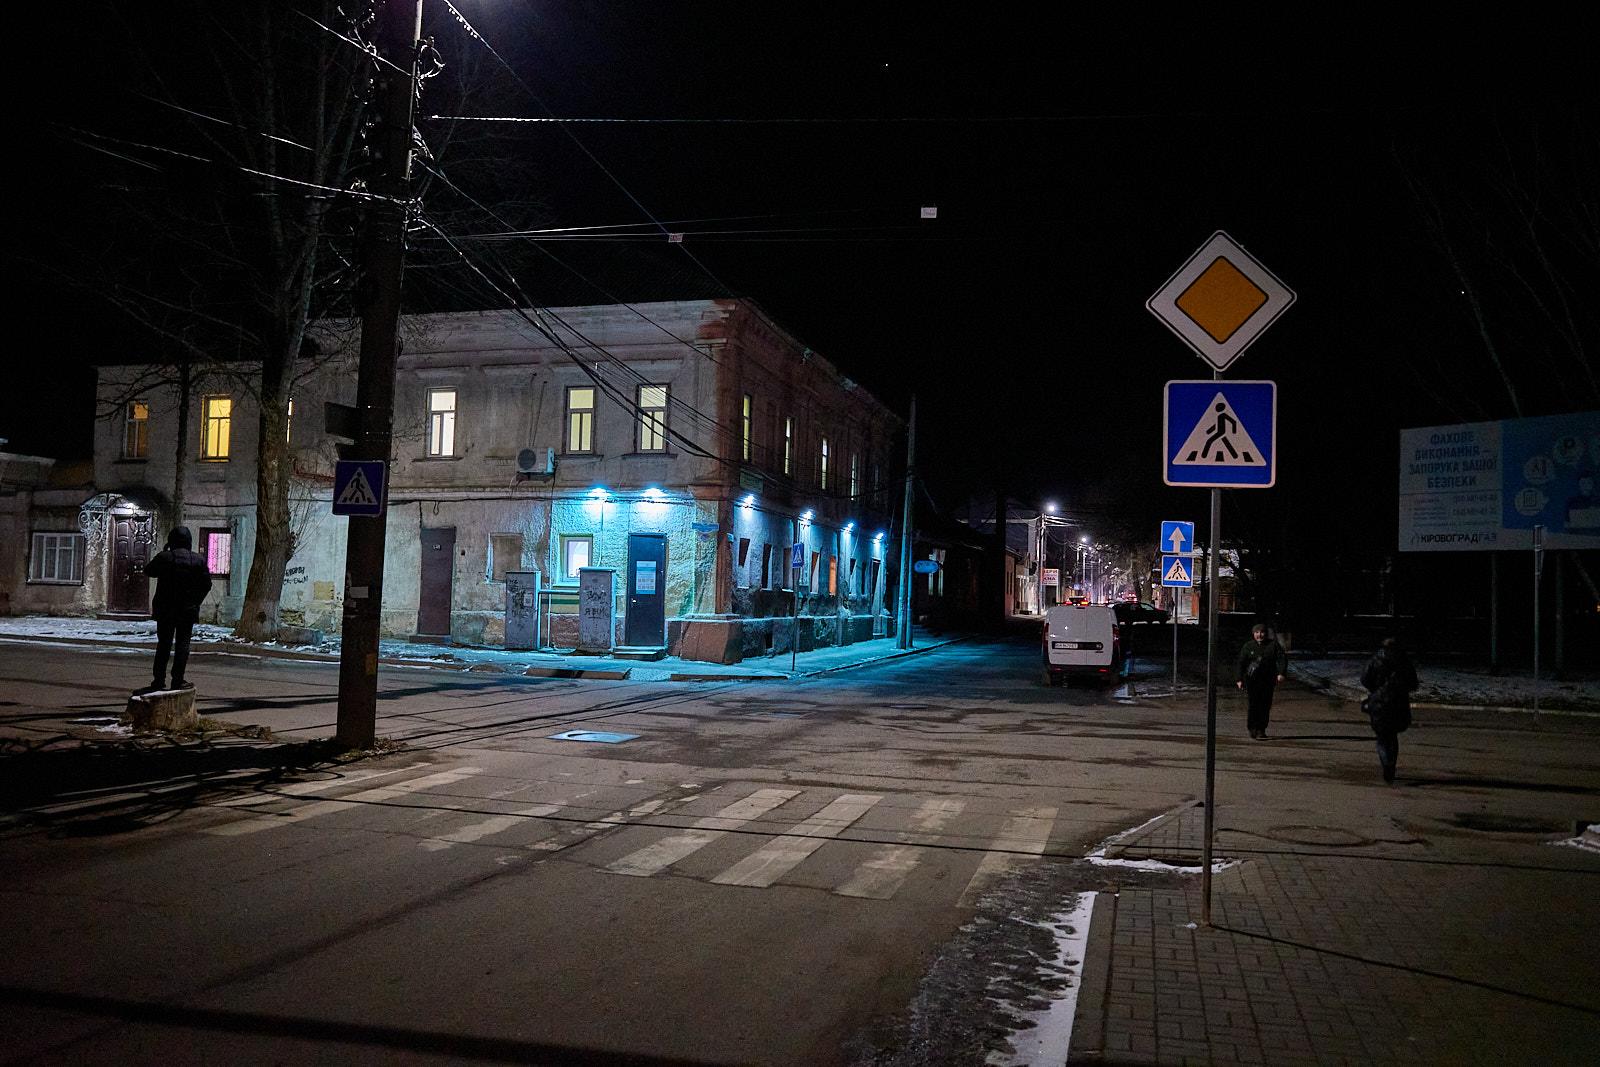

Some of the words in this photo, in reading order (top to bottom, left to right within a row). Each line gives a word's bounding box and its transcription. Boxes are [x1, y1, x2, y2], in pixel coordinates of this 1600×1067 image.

[1430, 431, 1474, 444] ФАХОВЕ
[1409, 462, 1460, 475] ЗАПОРУКА
[1427, 475, 1477, 488] БЕЗПЕКИ
[1421, 533, 1497, 544] КІРОВОГРАДГАЗ
